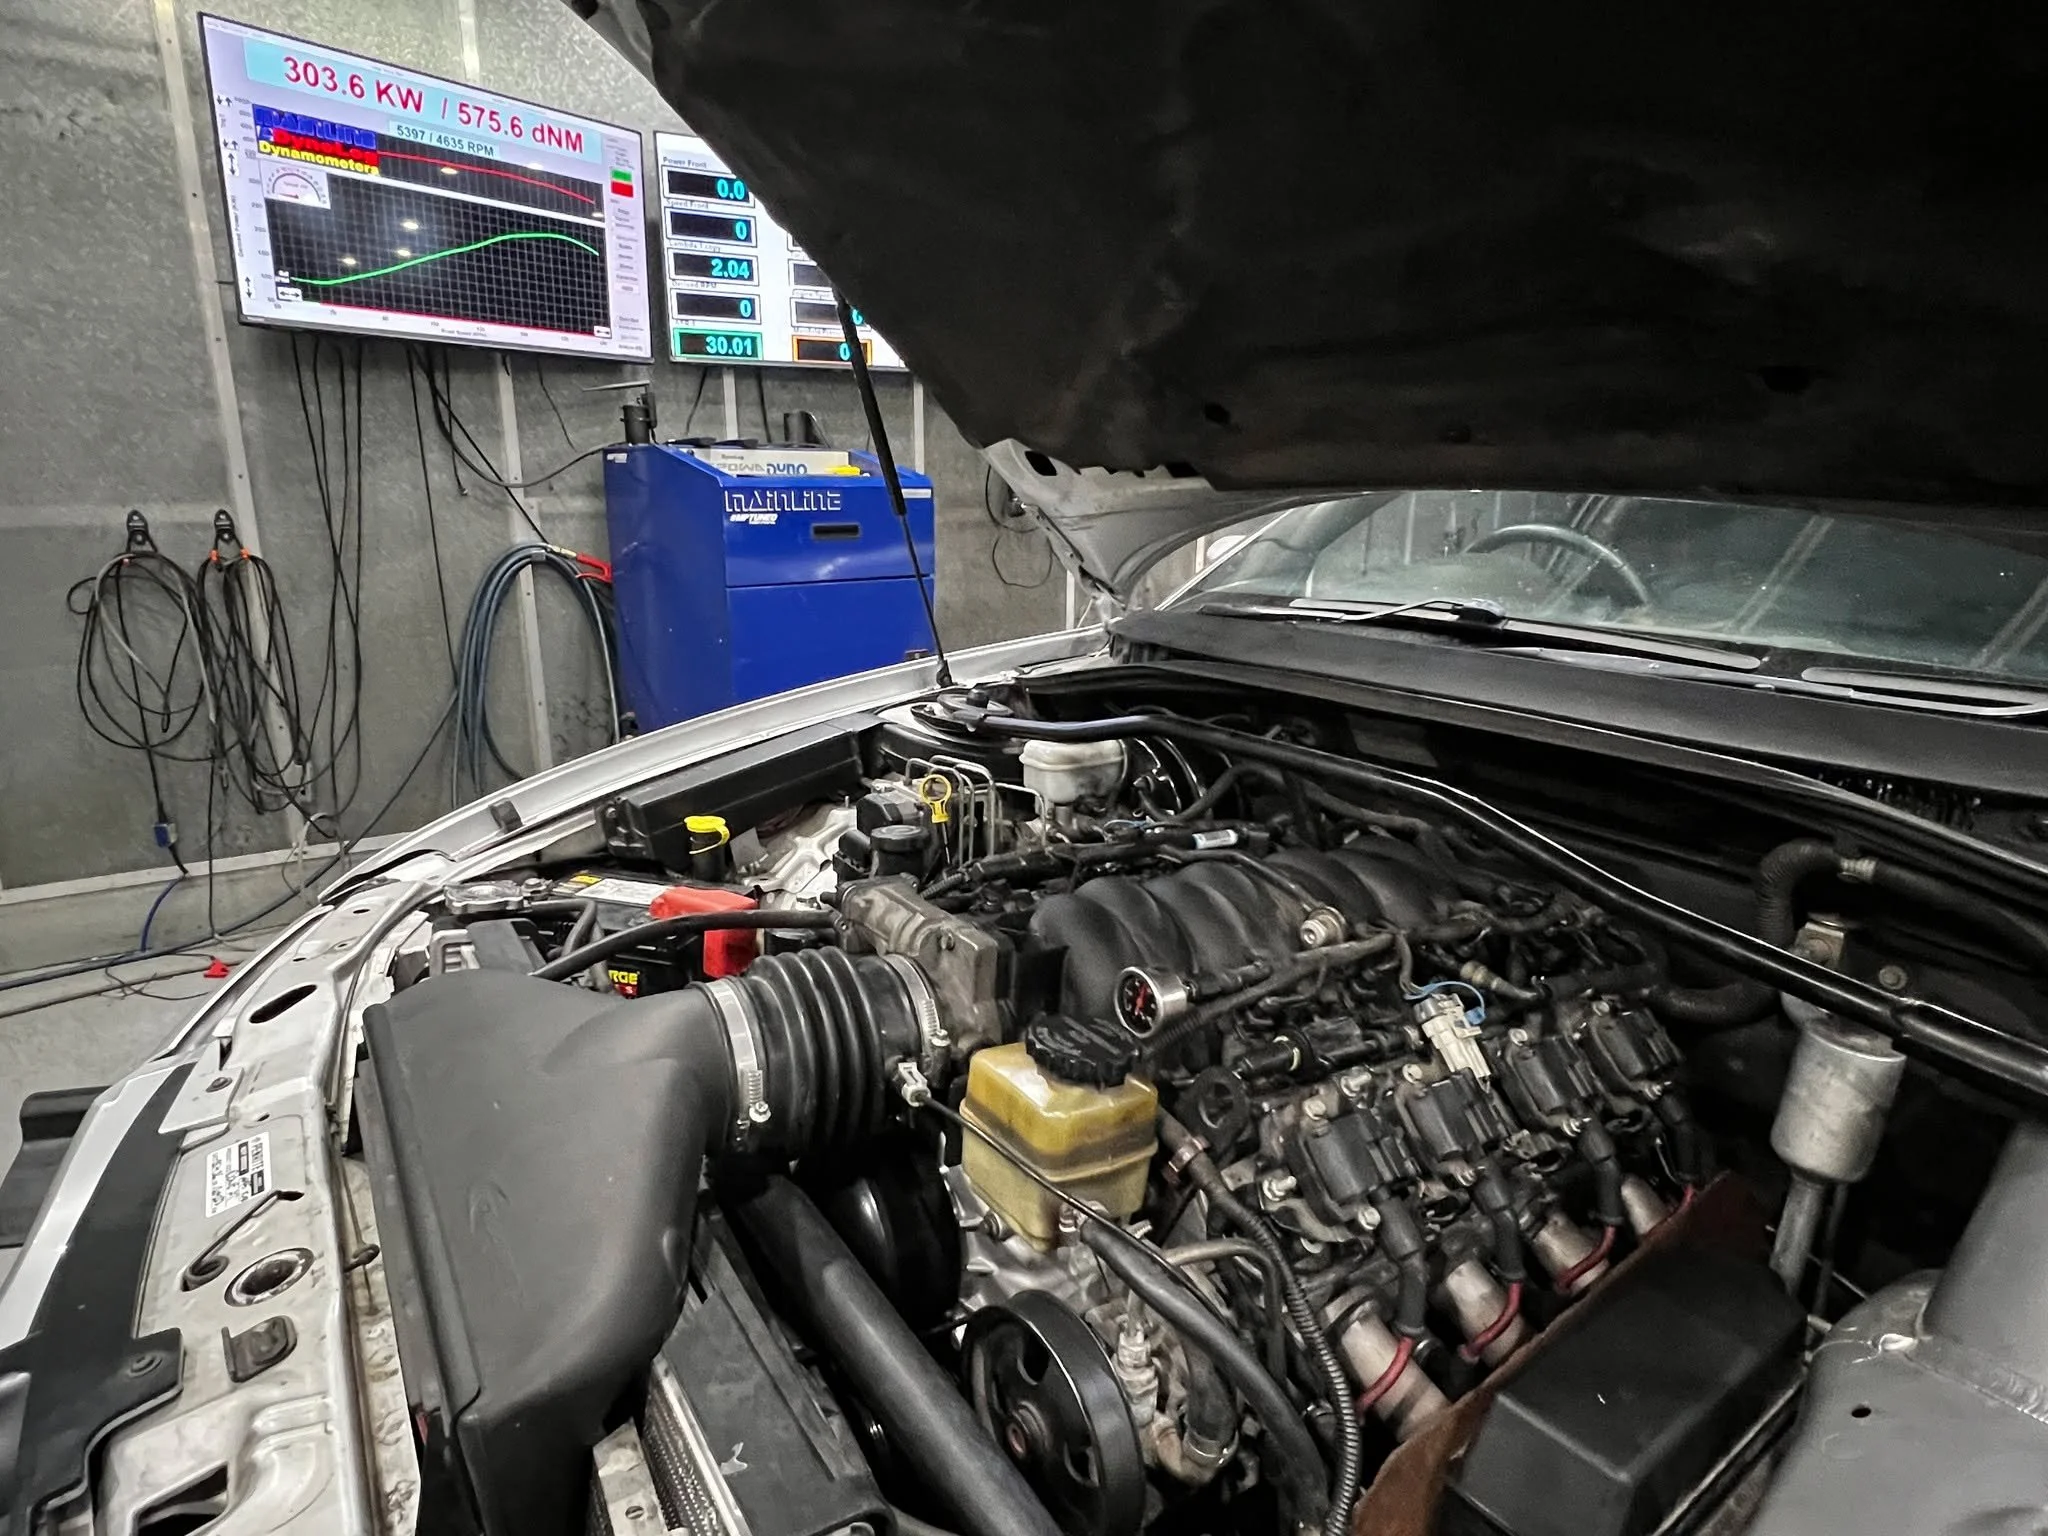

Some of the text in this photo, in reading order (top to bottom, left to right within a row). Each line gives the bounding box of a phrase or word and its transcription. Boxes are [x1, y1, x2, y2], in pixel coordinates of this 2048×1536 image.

[283, 56, 366, 99] 303.6
[376, 79, 424, 114] KW
[457, 102, 524, 139] 575.6
[532, 124, 585, 154] dNM
[397, 124, 426, 141] 5397
[436, 134, 465, 151] 4635
[467, 141, 495, 158] RPM
[259, 140, 380, 175] Dynamometers
[717, 178, 745, 200] 0.0
[735, 221, 747, 240] 0
[711, 258, 750, 279] 2.04
[740, 299, 752, 318] 0
[705, 335, 753, 356] 30.01
